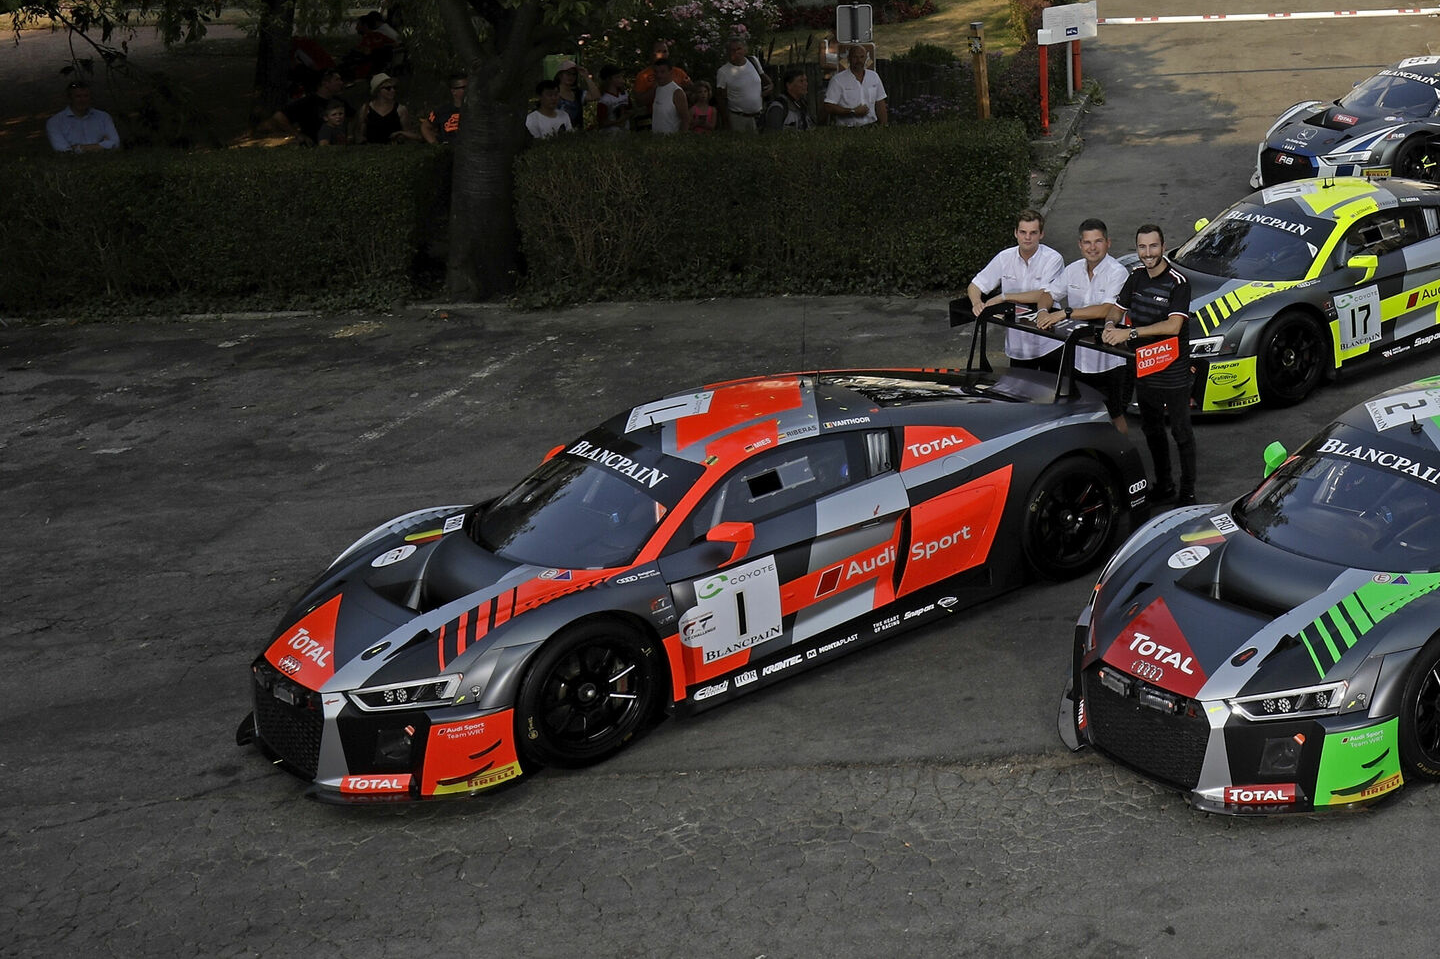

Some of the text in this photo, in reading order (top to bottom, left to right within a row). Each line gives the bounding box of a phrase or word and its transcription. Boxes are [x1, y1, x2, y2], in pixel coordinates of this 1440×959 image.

[1378, 70, 1440, 85] BLANCPAIN
[1337, 115, 1353, 123] TOTAL
[1278, 155, 1294, 165] R8
[1226, 210, 1312, 236] BLANCPAIN
[1354, 290, 1378, 302] COYOTE
[1350, 304, 1371, 339] 17
[1340, 332, 1381, 351] BLANCPAIN
[1138, 343, 1172, 358] TOTAL
[831, 416, 871, 429] VANTHOOR
[786, 425, 818, 437] RIBERAS
[753, 437, 771, 449] MIES
[907, 433, 964, 458] TOTAL
[566, 440, 669, 489] BLANCPAIN
[1214, 516, 1235, 531] PRO
[846, 526, 971, 580] Audi Sport
[730, 564, 775, 585] COYOTE
[736, 591, 748, 636] 1
[884, 615, 900, 626] HEART
[882, 620, 900, 631] RACING
[288, 627, 333, 668] TOTAL
[705, 625, 781, 662] BLANCPAIN
[819, 634, 858, 654] MONTAPLAST
[1129, 632, 1194, 675] TOTAL
[446, 722, 484, 734] Audi Sport
[447, 728, 484, 739] Team WRT
[1350, 730, 1384, 742] Audi Sport
[348, 777, 402, 790] TOTAL
[467, 767, 515, 788] PIRELLI
[1361, 774, 1400, 797] PIRELLI
[1229, 788, 1288, 802] TOTAL
